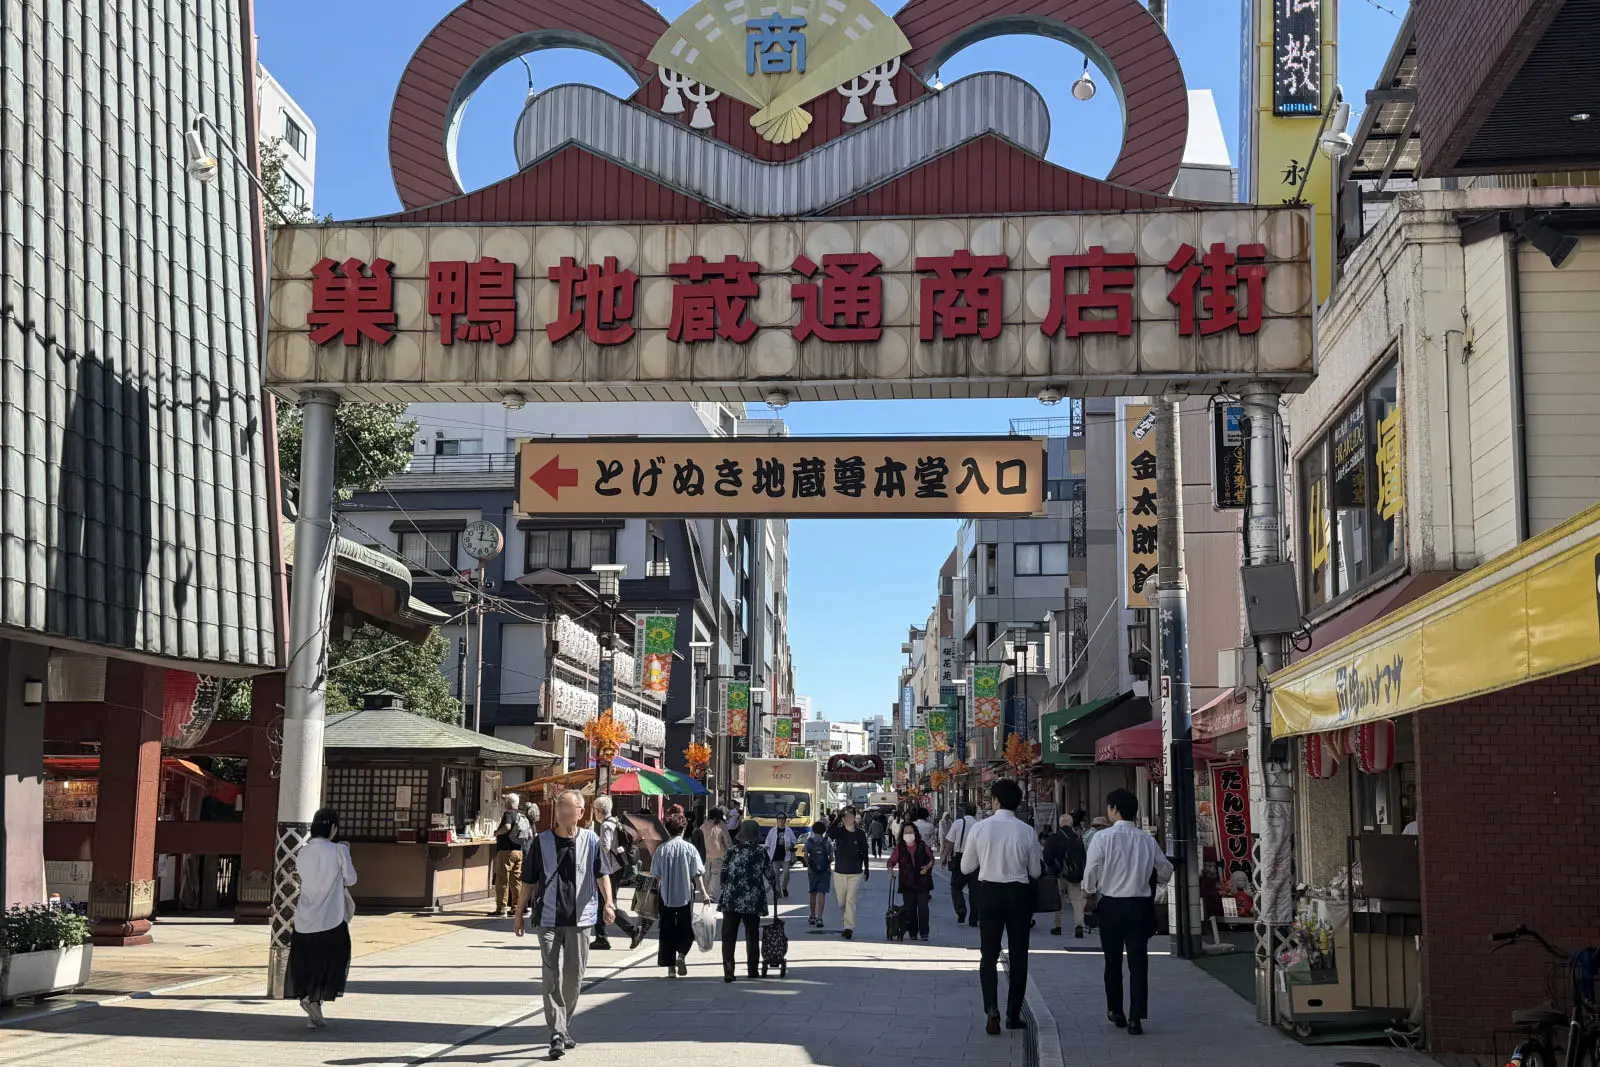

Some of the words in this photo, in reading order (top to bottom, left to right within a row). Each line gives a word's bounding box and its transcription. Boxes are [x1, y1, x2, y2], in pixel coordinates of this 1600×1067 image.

[746, 12, 807, 75] 商
[307, 242, 1267, 346] 巣鴨地蔵通商店街
[594, 455, 1029, 498] とげぬき地蔵尊本堂入口
